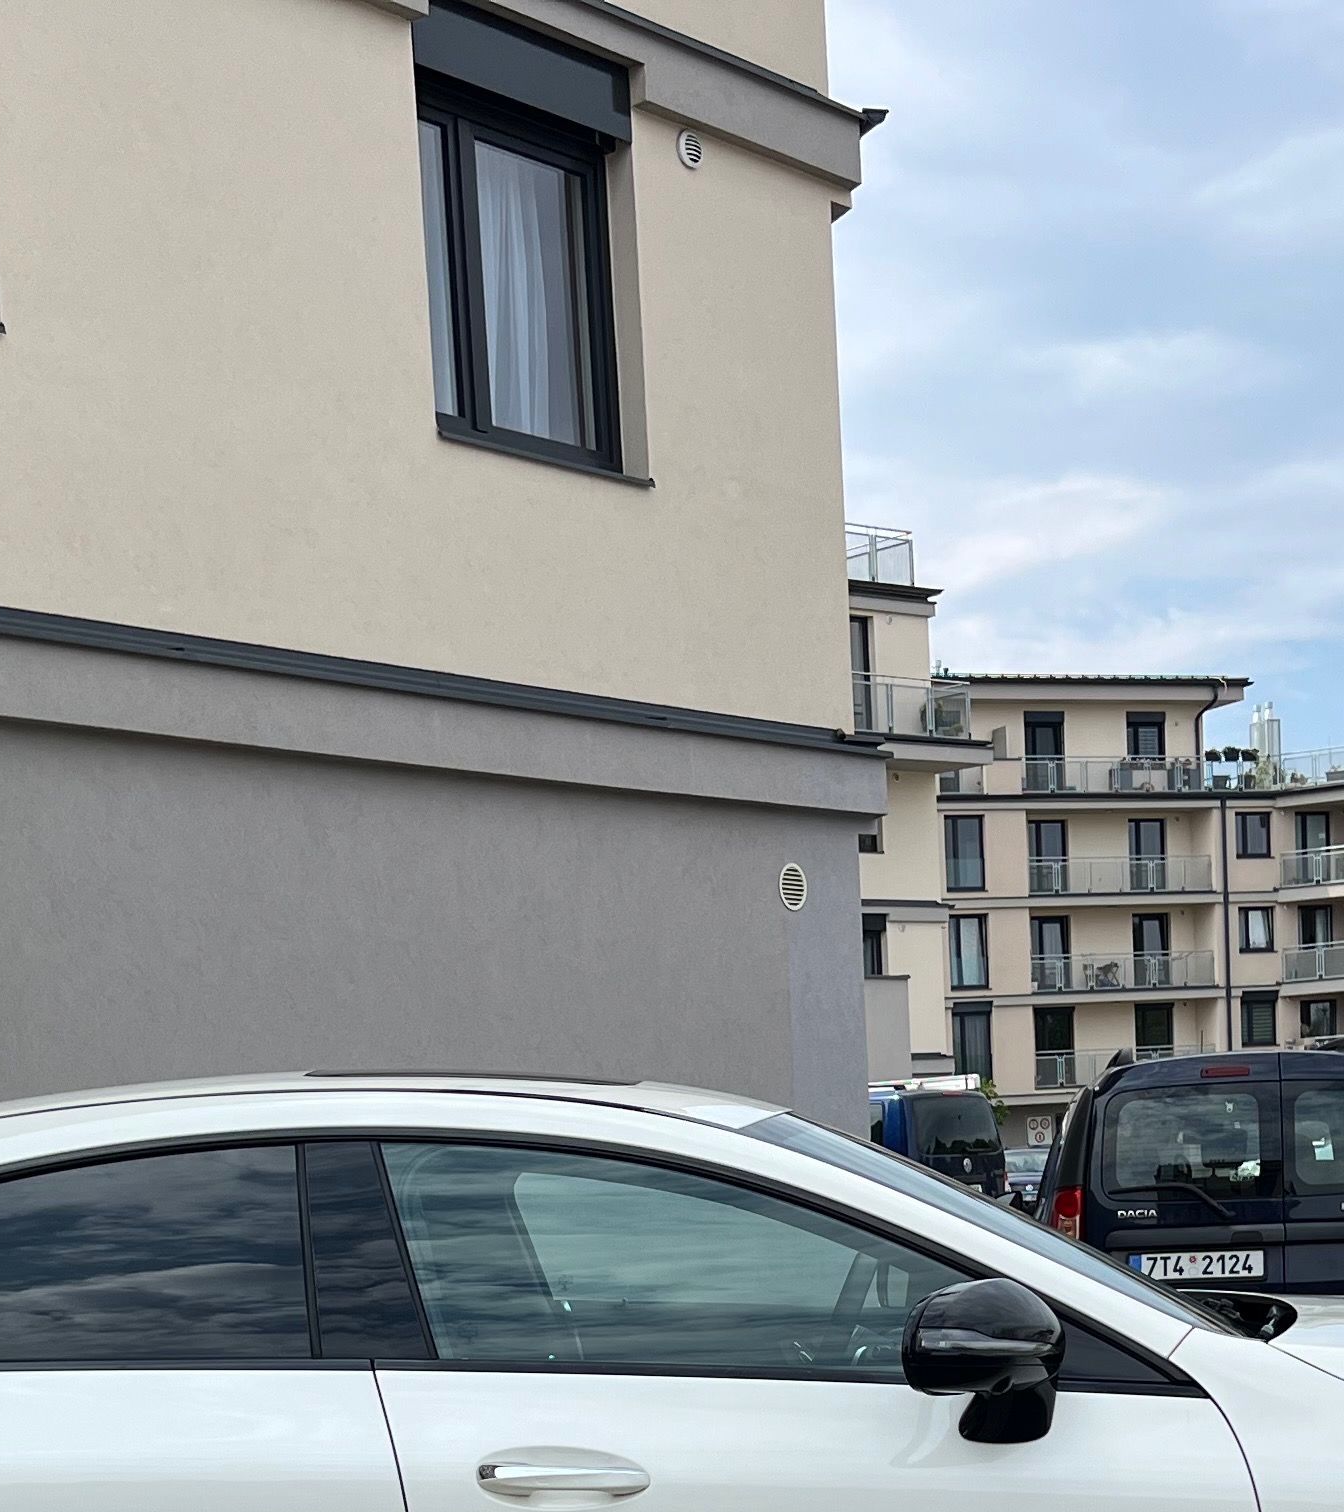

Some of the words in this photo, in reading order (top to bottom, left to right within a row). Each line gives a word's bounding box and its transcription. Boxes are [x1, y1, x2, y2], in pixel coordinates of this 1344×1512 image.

[1117, 1209, 1158, 1219] DACIA
[1146, 1255, 1185, 1277] 7T4
[1202, 1253, 1253, 1276] 2124
